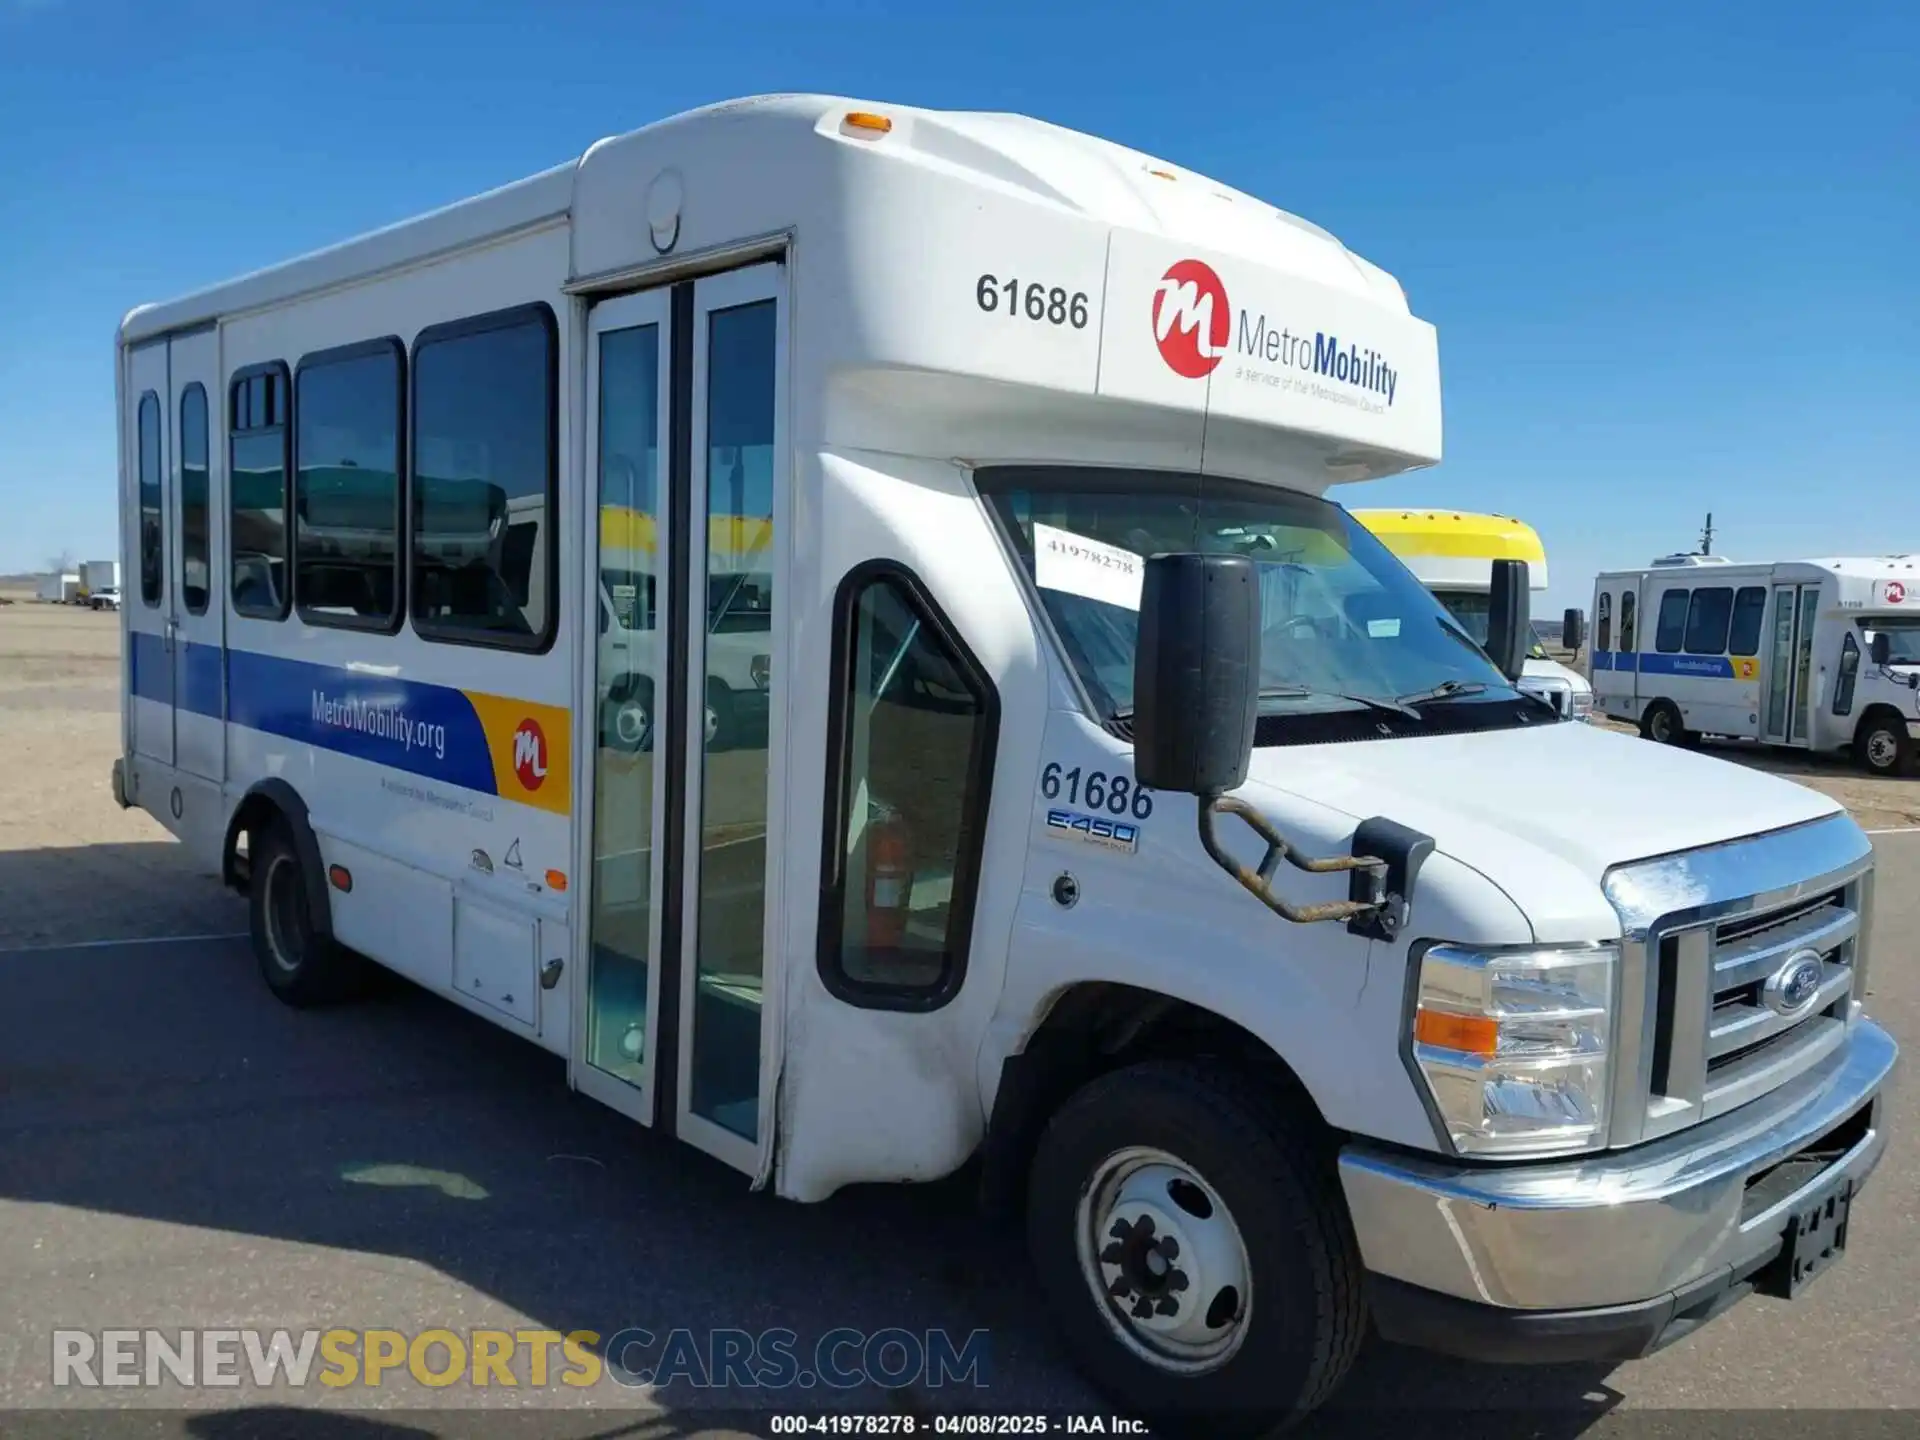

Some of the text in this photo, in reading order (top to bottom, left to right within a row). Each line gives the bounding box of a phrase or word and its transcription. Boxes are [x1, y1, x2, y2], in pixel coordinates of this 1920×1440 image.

[976, 273, 1088, 329] 61686
[1237, 309, 1397, 407] MetroMobility
[1047, 540, 1134, 574] 41978278
[311, 690, 446, 759] MetroMobility.org
[1041, 762, 1153, 820] 61686
